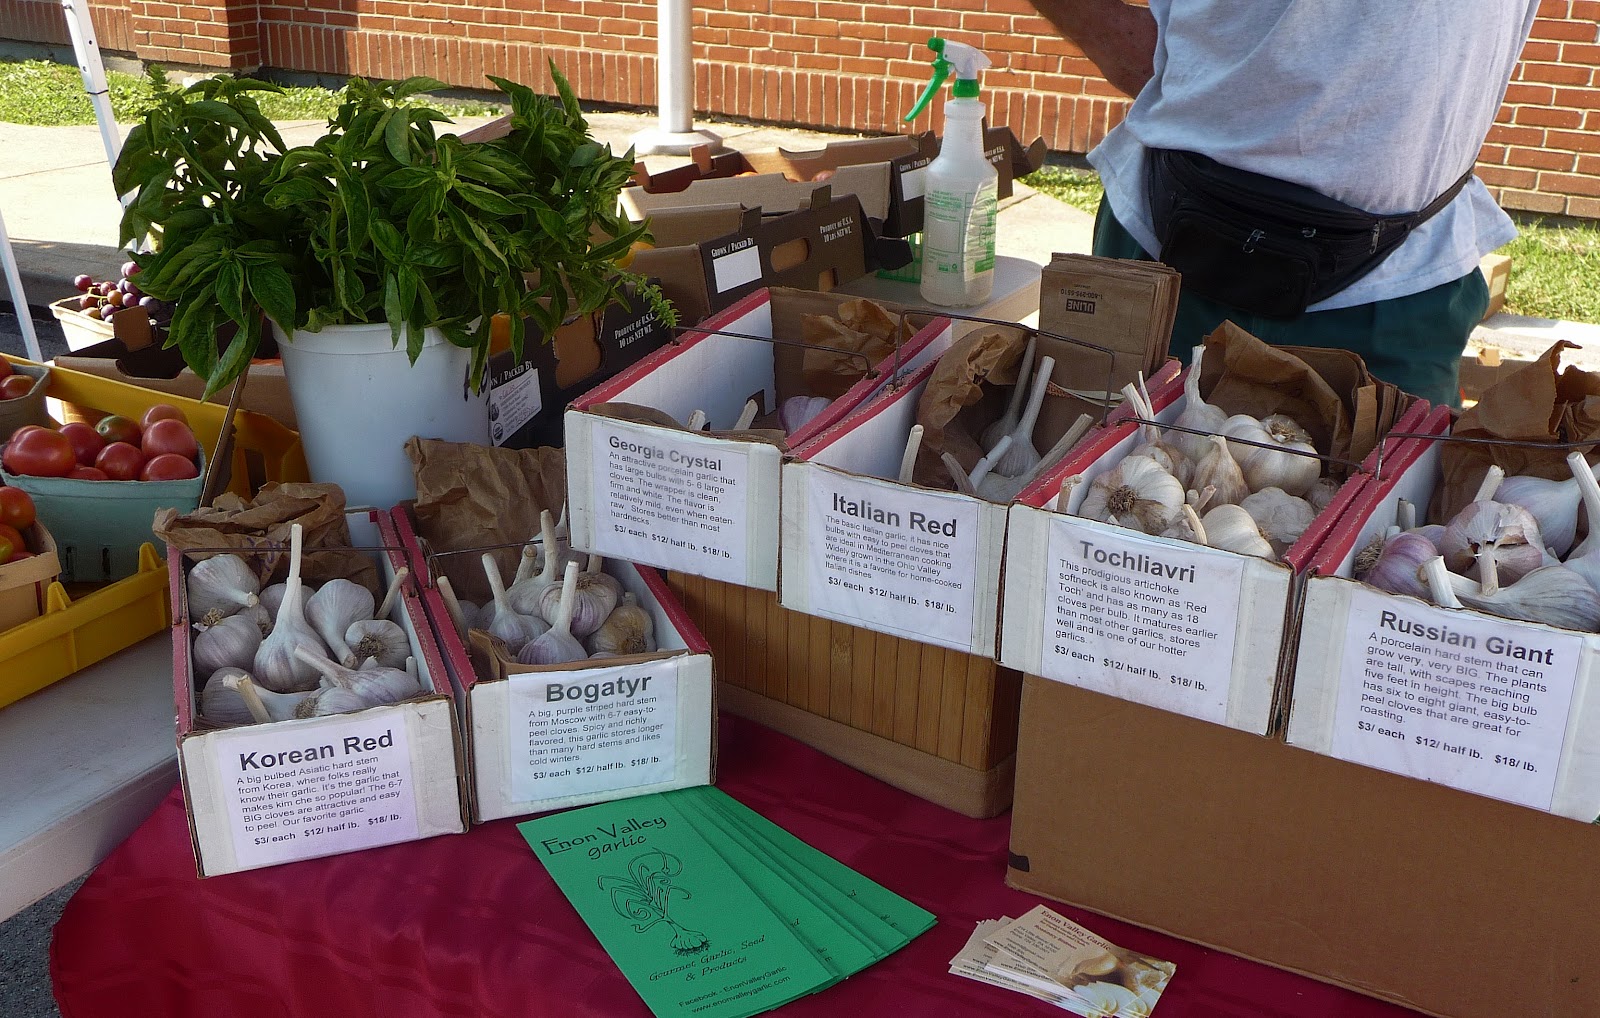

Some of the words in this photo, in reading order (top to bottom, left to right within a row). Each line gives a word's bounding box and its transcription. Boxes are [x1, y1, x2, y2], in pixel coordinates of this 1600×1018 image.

[1067, 299, 1094, 312] ULINE
[609, 435, 664, 459] Georgia
[669, 449, 722, 471] Crystal
[631, 504, 655, 517] Stores
[657, 511, 679, 522] better
[682, 516, 699, 527] than
[700, 523, 720, 532] most
[833, 492, 900, 525] Italian
[909, 510, 957, 539] Red
[614, 524, 626, 533] $3/
[628, 529, 647, 538] each
[652, 533, 669, 543] $12/
[671, 537, 686, 547] half
[688, 541, 698, 550] lb.
[702, 545, 720, 556] $18/
[722, 549, 732, 559] lb.
[825, 535, 838, 543] are
[839, 536, 856, 547] ideal
[858, 540, 865, 549] in
[867, 543, 920, 562] Mediterranean
[922, 557, 952, 571] cooking
[1060, 559, 1080, 572] This
[1082, 566, 1132, 584] prodigious
[1134, 579, 1179, 595] artichoke
[1079, 541, 1195, 583] Tochliavri
[828, 576, 842, 586] $3/
[843, 582, 864, 592] each
[869, 586, 887, 597] $12/
[889, 591, 906, 602] half
[908, 595, 920, 605] lb.
[925, 599, 944, 611] $18/
[946, 604, 957, 614] lb.
[1059, 573, 1098, 588] softneck
[1100, 580, 1109, 590] is
[1111, 584, 1131, 596] also
[1134, 588, 1165, 604] known
[1169, 598, 1180, 607] as
[1369, 631, 1378, 641] A
[1381, 636, 1432, 654] porcelain
[1435, 646, 1461, 660] hard
[1464, 654, 1493, 667] stem
[1496, 660, 1519, 674] that
[1521, 668, 1543, 679] can
[1380, 611, 1477, 648] Russian
[1485, 635, 1554, 666] Giant
[1054, 644, 1069, 656] $3/
[1071, 651, 1095, 662] each
[1103, 656, 1124, 670] $12/
[1127, 662, 1146, 675] half
[1149, 668, 1161, 679] lb.
[1170, 673, 1192, 687] $18/
[1195, 679, 1208, 691] lb.
[1366, 658, 1384, 668] are
[1410, 668, 1432, 679] with
[1436, 674, 1476, 690] scapes
[1479, 684, 1530, 705] reaching
[528, 710, 536, 718] A
[556, 704, 583, 716] purple
[586, 700, 614, 711] striped
[616, 697, 634, 707] hard
[637, 696, 657, 704] stem
[546, 675, 652, 703] Bogatyr
[529, 720, 548, 728] from
[551, 715, 587, 725] Moscow
[589, 711, 605, 720] with
[607, 709, 621, 718] 6-7
[240, 743, 334, 771] Korean
[344, 729, 393, 754] Red
[1358, 720, 1375, 733] $3/
[1378, 727, 1405, 740] each
[1416, 734, 1441, 749] $12/
[1443, 741, 1466, 755] half
[1469, 747, 1483, 759] lb.
[1494, 753, 1520, 768] $18/
[1523, 760, 1538, 773] lb.
[236, 777, 244, 785] A
[247, 775, 261, 784] big
[264, 768, 296, 781] bulbed
[298, 764, 330, 775] Asiatic
[332, 759, 353, 769] hard
[356, 756, 378, 765] stem
[533, 771, 547, 780] $3/
[549, 767, 571, 777] each
[576, 764, 594, 774] $12/
[596, 761, 613, 771] half
[615, 760, 626, 768] lb.
[631, 756, 649, 767] $18/
[651, 755, 661, 763] lb.
[240, 795, 265, 804] know
[267, 790, 289, 800] their
[322, 782, 335, 790] It's
[338, 779, 353, 787] the
[355, 774, 380, 786] garlic
[382, 770, 400, 780] that
[254, 835, 269, 846] $3/
[272, 831, 296, 842] each
[304, 826, 324, 837] $12/
[327, 822, 345, 832] half
[348, 820, 360, 829] lb.
[368, 814, 388, 826] $18/
[390, 813, 402, 821] lb.
[540, 834, 598, 855] Enon
[596, 816, 667, 838] Valley
[588, 834, 647, 860] garlic
[1041, 910, 1061, 924] Enon
[1063, 921, 1086, 937] Valley
[1086, 936, 1111, 950] Garlic
[650, 961, 696, 982] Gourmet
[700, 948, 736, 964] Garlic,
[741, 934, 766, 950] Seed
[685, 972, 696, 982] &
[702, 956, 748, 977] Products
[678, 991, 718, 1008] Facebook
[723, 966, 788, 994] EnonValleyGarlic
[692, 976, 790, 1014] www.enonvalleygarlic.com
